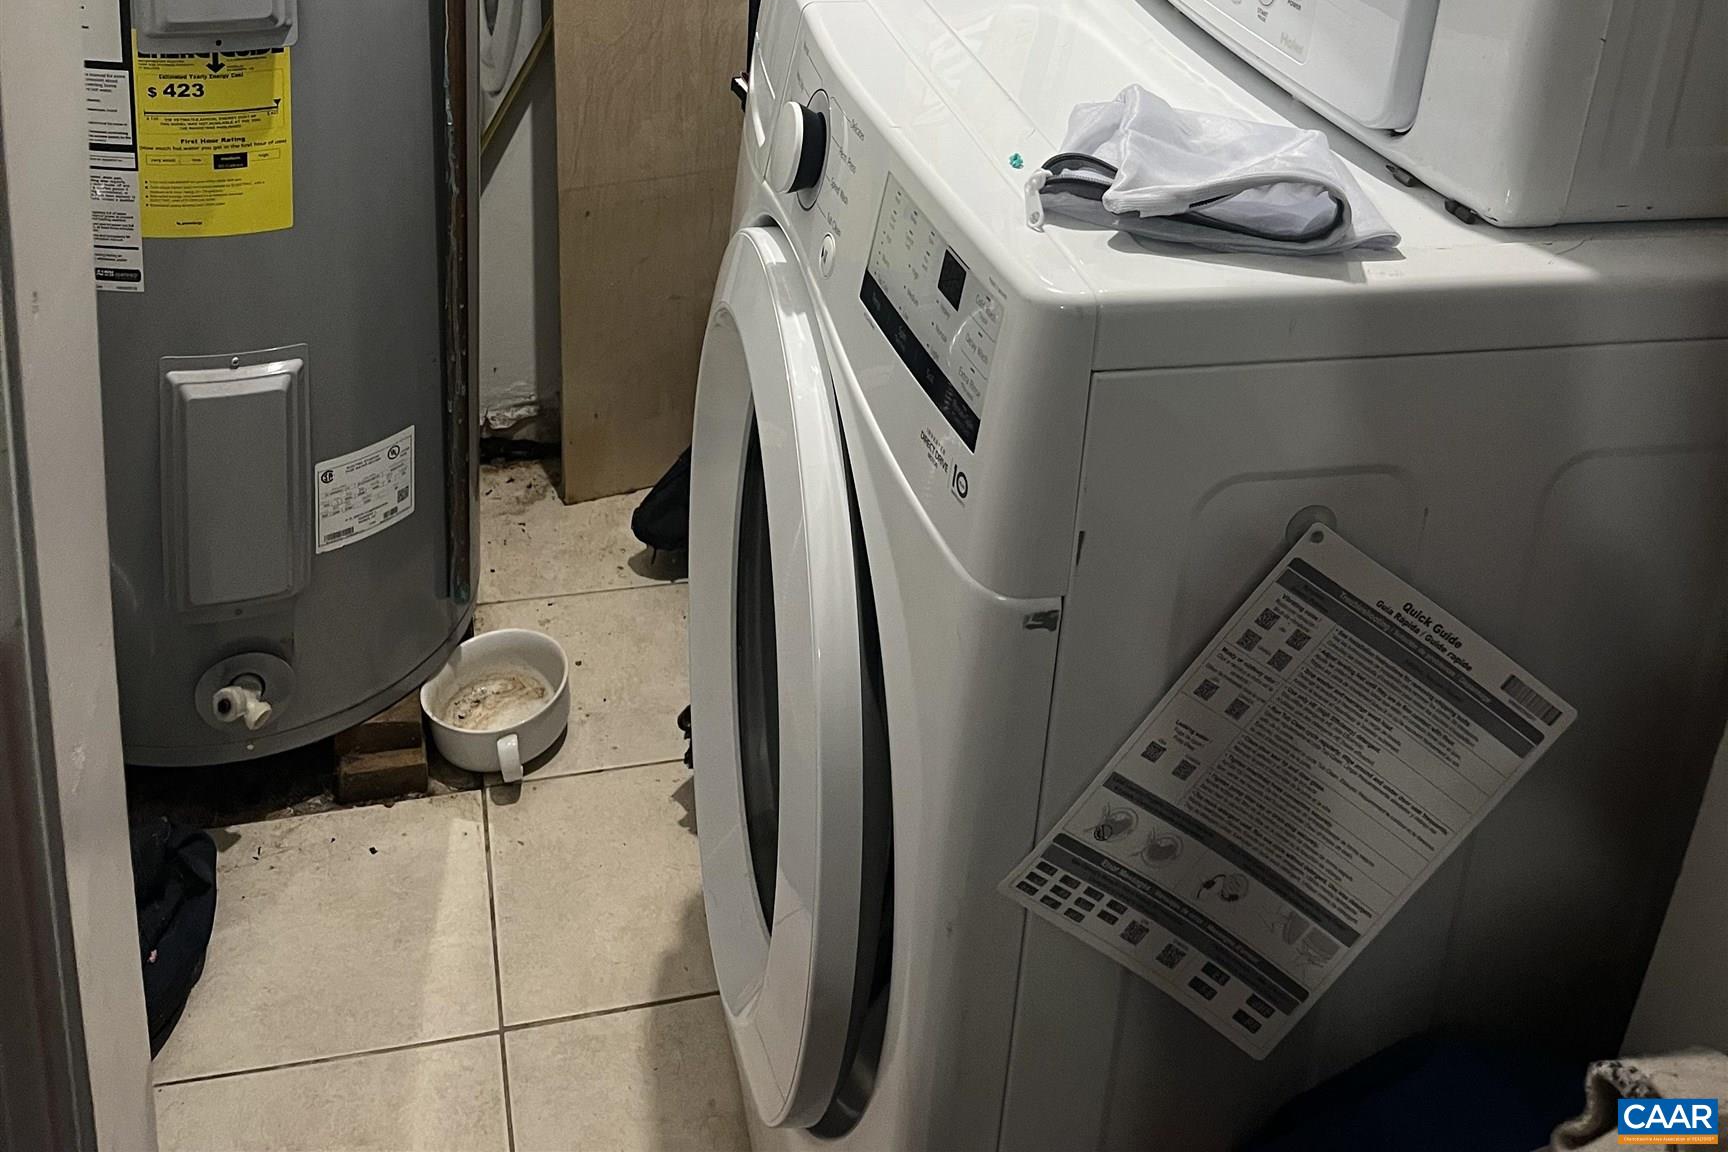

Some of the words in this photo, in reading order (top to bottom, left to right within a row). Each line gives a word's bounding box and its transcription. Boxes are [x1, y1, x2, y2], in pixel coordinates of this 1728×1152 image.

[147, 86, 158, 99] $
[162, 83, 205, 98] 423
[221, 136, 246, 144] Rating
[920, 430, 936, 455] DIRECT
[934, 452, 949, 473] DRIVE
[952, 463, 969, 499] 10
[1400, 600, 1435, 629] Quick
[1430, 622, 1465, 650] Guide
[1422, 633, 1449, 655] Guide
